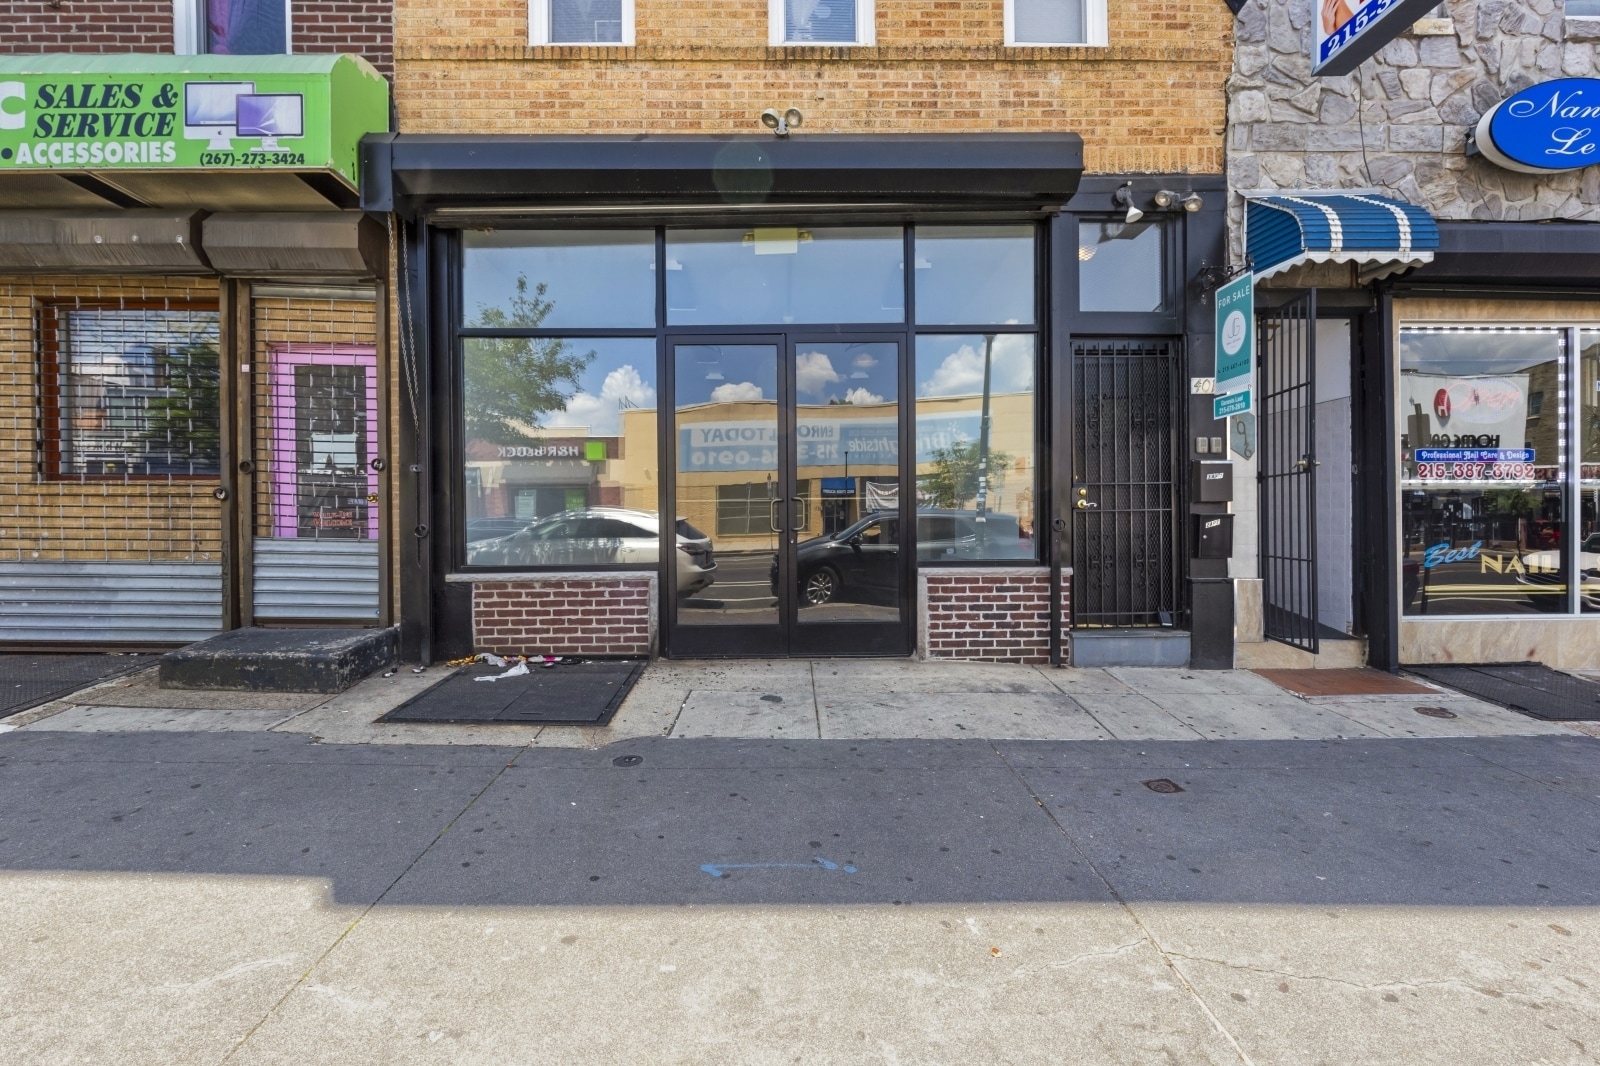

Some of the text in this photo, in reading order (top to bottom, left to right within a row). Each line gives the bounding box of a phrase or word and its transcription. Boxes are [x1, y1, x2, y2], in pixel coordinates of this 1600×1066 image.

[34, 82, 179, 110] SALES &
[32, 112, 177, 139] SERVICE
[15, 141, 177, 165] ACCESSORIES
[1545, 126, 1597, 156] Le
[199, 152, 305, 167] (267)-273-3424
[1218, 285, 1250, 309] FOR SALE
[1421, 450, 1462, 460] Professional
[1480, 450, 1498, 460] Care
[1417, 462, 1535, 480] 215-387-3792
[1423, 540, 1558, 575] Best NAIL
